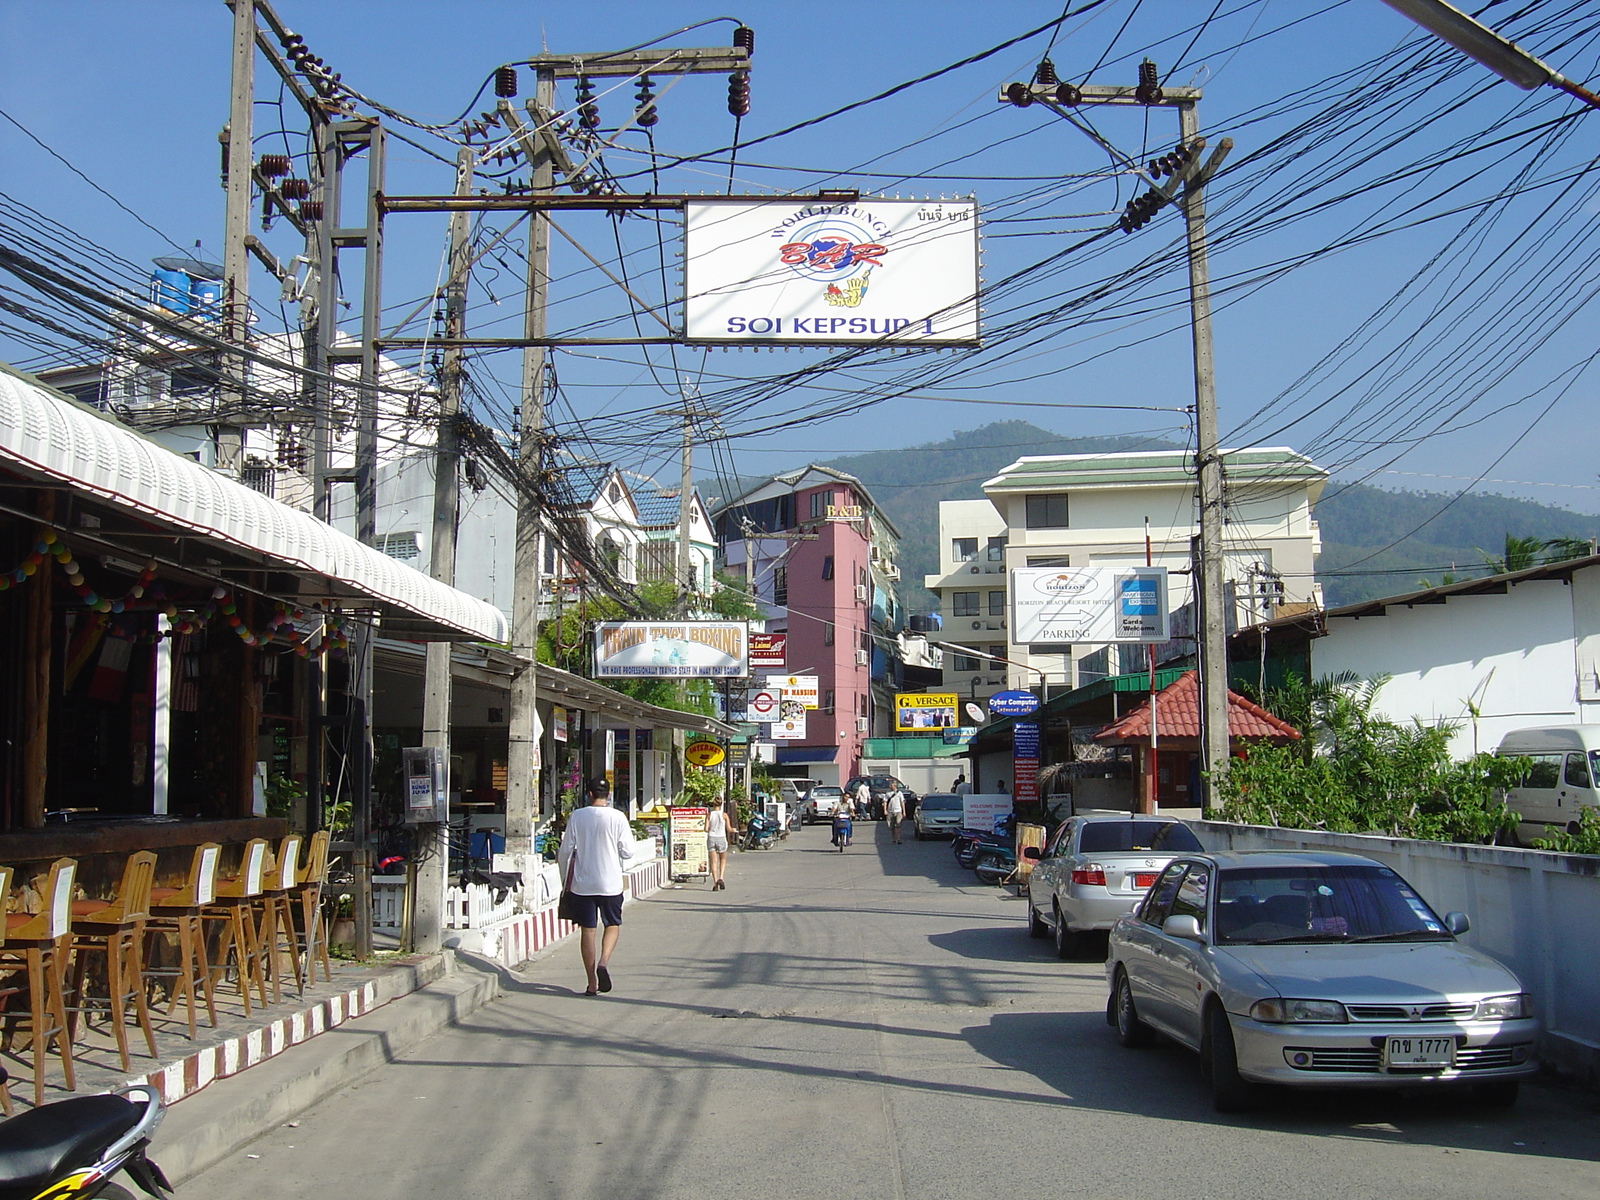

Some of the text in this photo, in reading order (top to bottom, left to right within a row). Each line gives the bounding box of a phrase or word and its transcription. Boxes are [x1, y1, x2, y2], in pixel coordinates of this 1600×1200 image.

[917, 204, 942, 221] บันจี้
[771, 204, 893, 239] WORLD BUNGY
[779, 242, 888, 268] BAR
[727, 317, 782, 334] SOI
[827, 505, 863, 517] B & B
[1043, 629, 1091, 640] PARKING
[602, 627, 742, 661] TRAIN THAI BOXING
[899, 697, 955, 708] G. VERSACE
[690, 744, 721, 755] INTERNET
[1418, 1039, 1450, 1054] 1777
